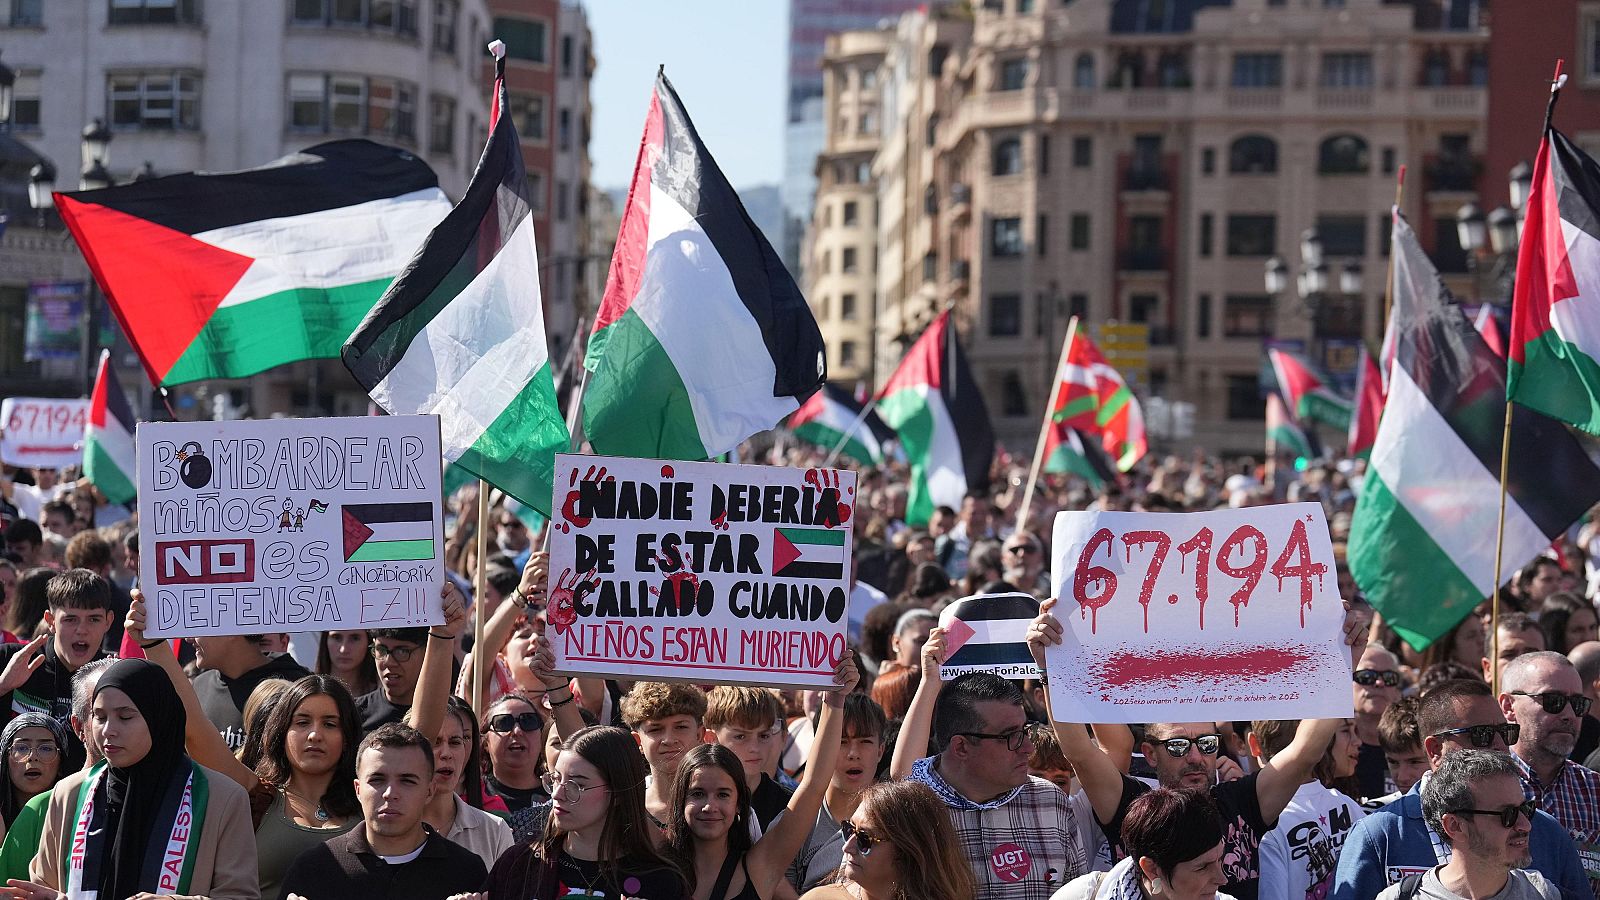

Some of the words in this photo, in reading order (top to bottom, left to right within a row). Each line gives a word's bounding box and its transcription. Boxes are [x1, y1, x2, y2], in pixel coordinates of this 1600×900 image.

[152, 435, 426, 491] BOMBARDEAR
[153, 491, 277, 536] niños
[579, 479, 694, 521] NADIE
[163, 542, 248, 579] NO
[261, 540, 330, 583] es
[575, 533, 616, 574] DE
[634, 530, 764, 575] ESTAR
[157, 585, 342, 631] DEFENSA
[359, 587, 429, 625] EZ!!!
[572, 579, 715, 618] CALLADO
[728, 580, 846, 624] CUANDO
[564, 620, 655, 659] NIÑOS
[661, 626, 728, 663] ESTAN
[739, 629, 847, 669] MURIENDO
[1279, 693, 1300, 701] 2025
[992, 849, 1024, 867] UGT
